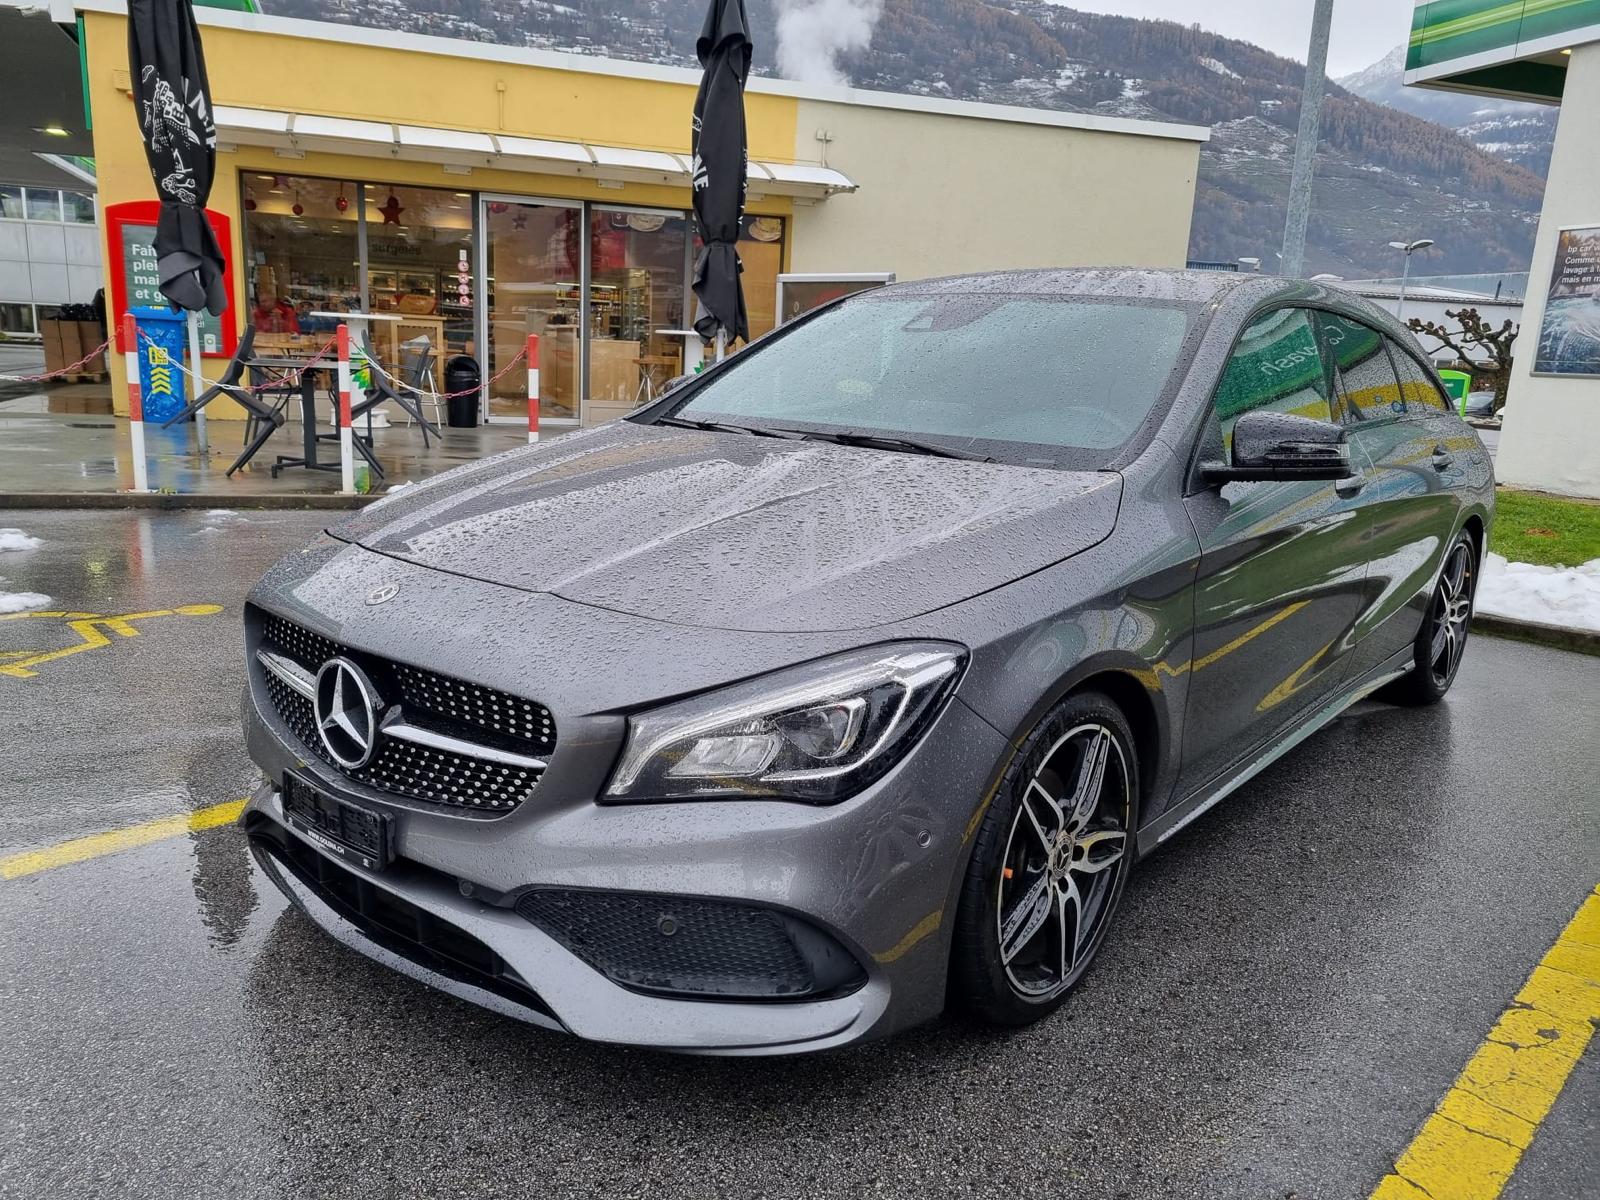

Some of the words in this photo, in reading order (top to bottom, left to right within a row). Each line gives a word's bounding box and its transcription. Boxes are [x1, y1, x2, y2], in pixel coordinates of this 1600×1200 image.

[1567, 245, 1578, 254] bp
[133, 259, 159, 272] plei
[1563, 265, 1588, 275] lavage
[134, 274, 160, 285] mai
[1561, 275, 1580, 284] mais
[135, 288, 150, 299] et
